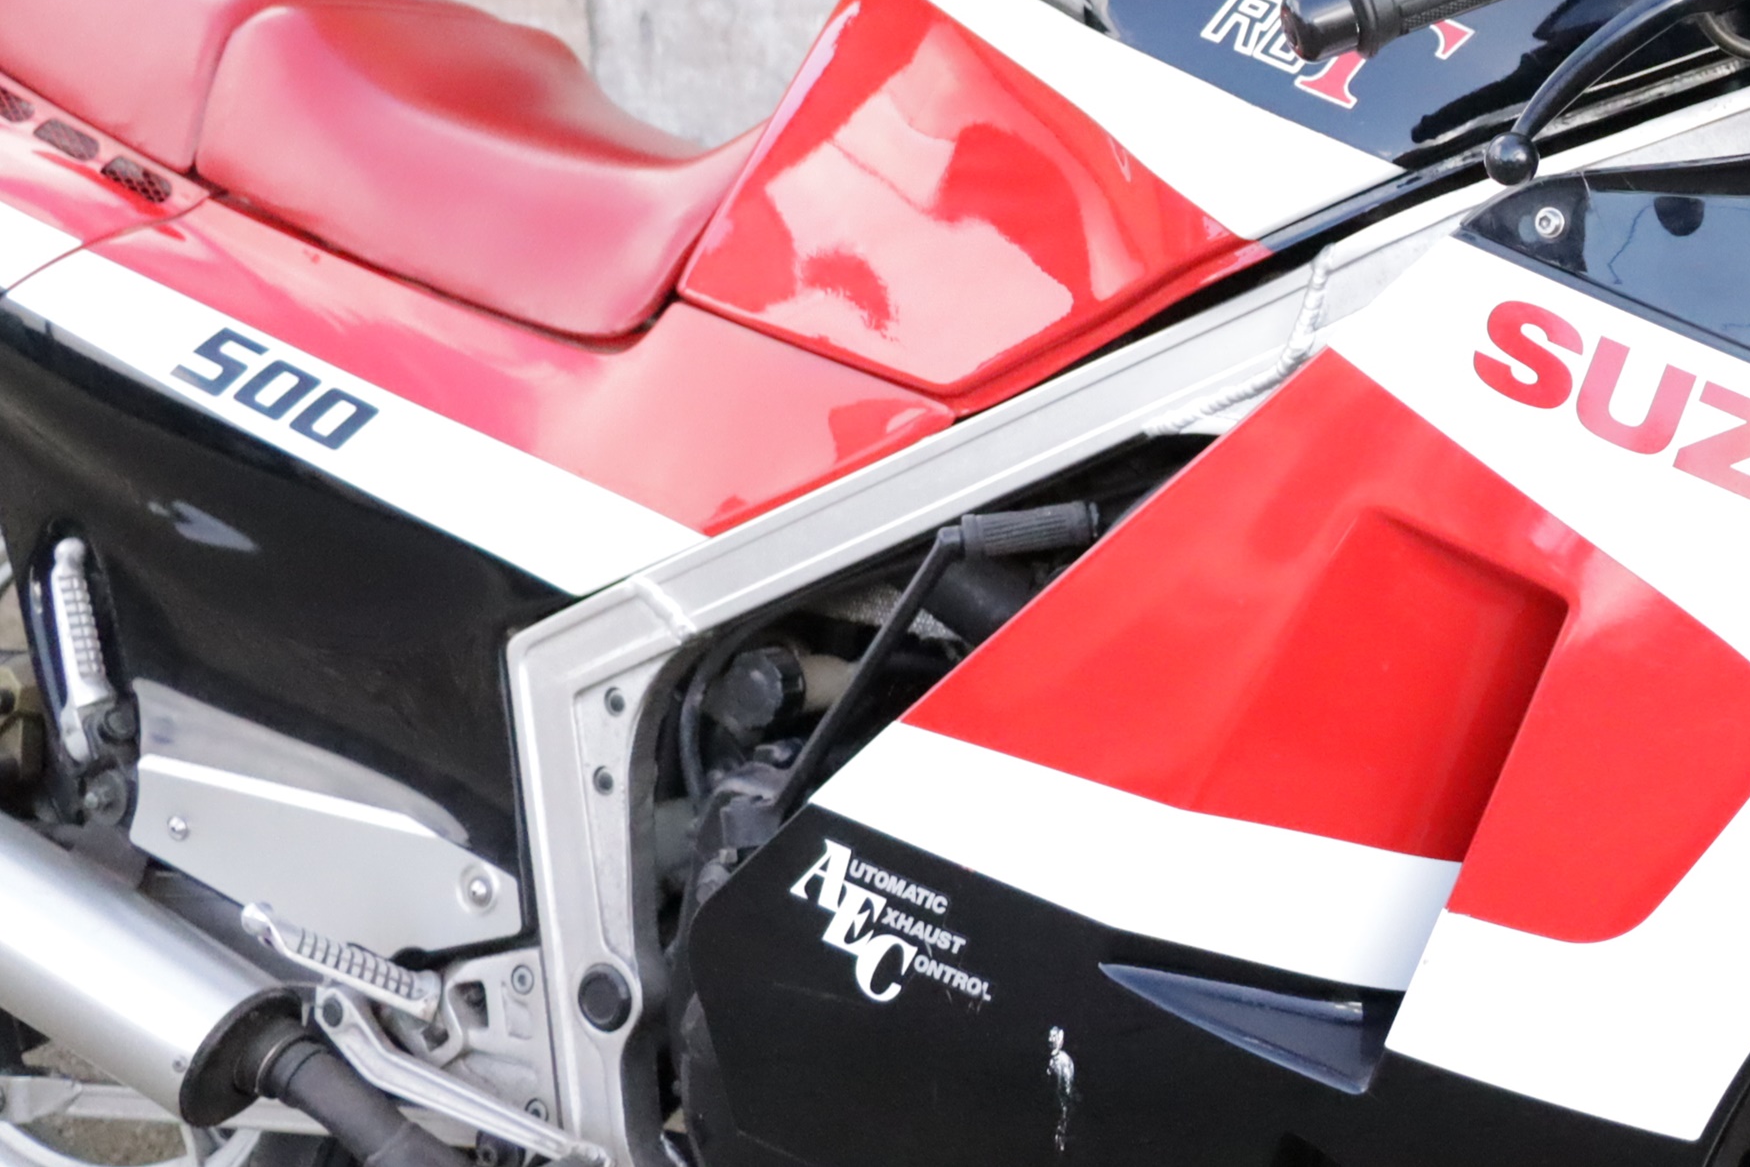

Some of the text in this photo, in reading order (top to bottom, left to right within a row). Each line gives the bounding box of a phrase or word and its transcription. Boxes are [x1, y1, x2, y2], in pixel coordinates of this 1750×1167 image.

[170, 327, 379, 451] 500
[789, 838, 949, 914] AUTOMATIC
[822, 880, 967, 956] EXHAUST
[855, 934, 992, 1002] CONTROL
